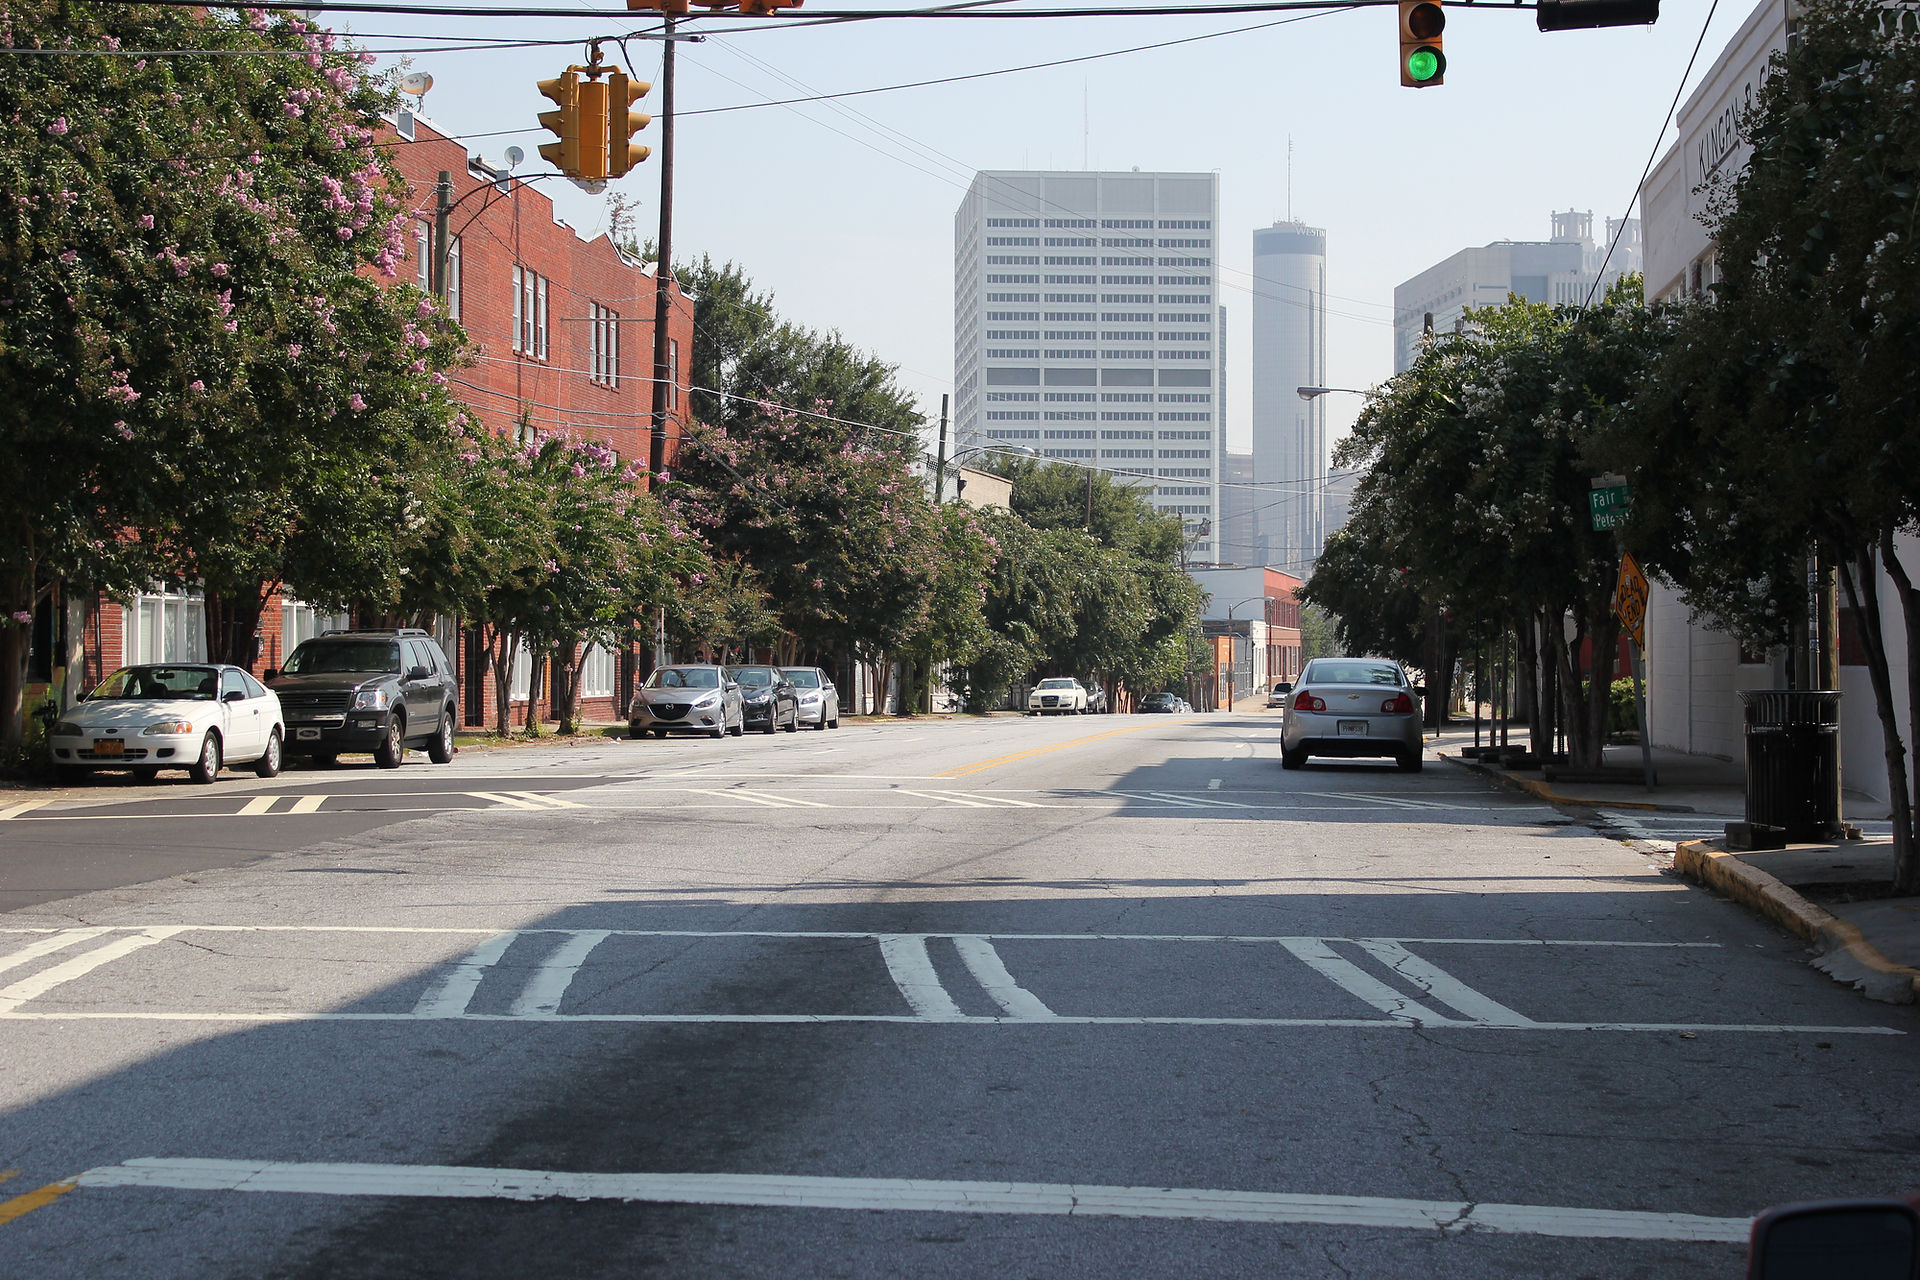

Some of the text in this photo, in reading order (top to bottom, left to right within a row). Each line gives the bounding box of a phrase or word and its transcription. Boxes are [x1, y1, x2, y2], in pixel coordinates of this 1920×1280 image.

[1295, 227, 1326, 238] WESTIN
[1592, 491, 1615, 508] Fair
[1620, 576, 1639, 601] DEAD
[1626, 600, 1640, 621] END
